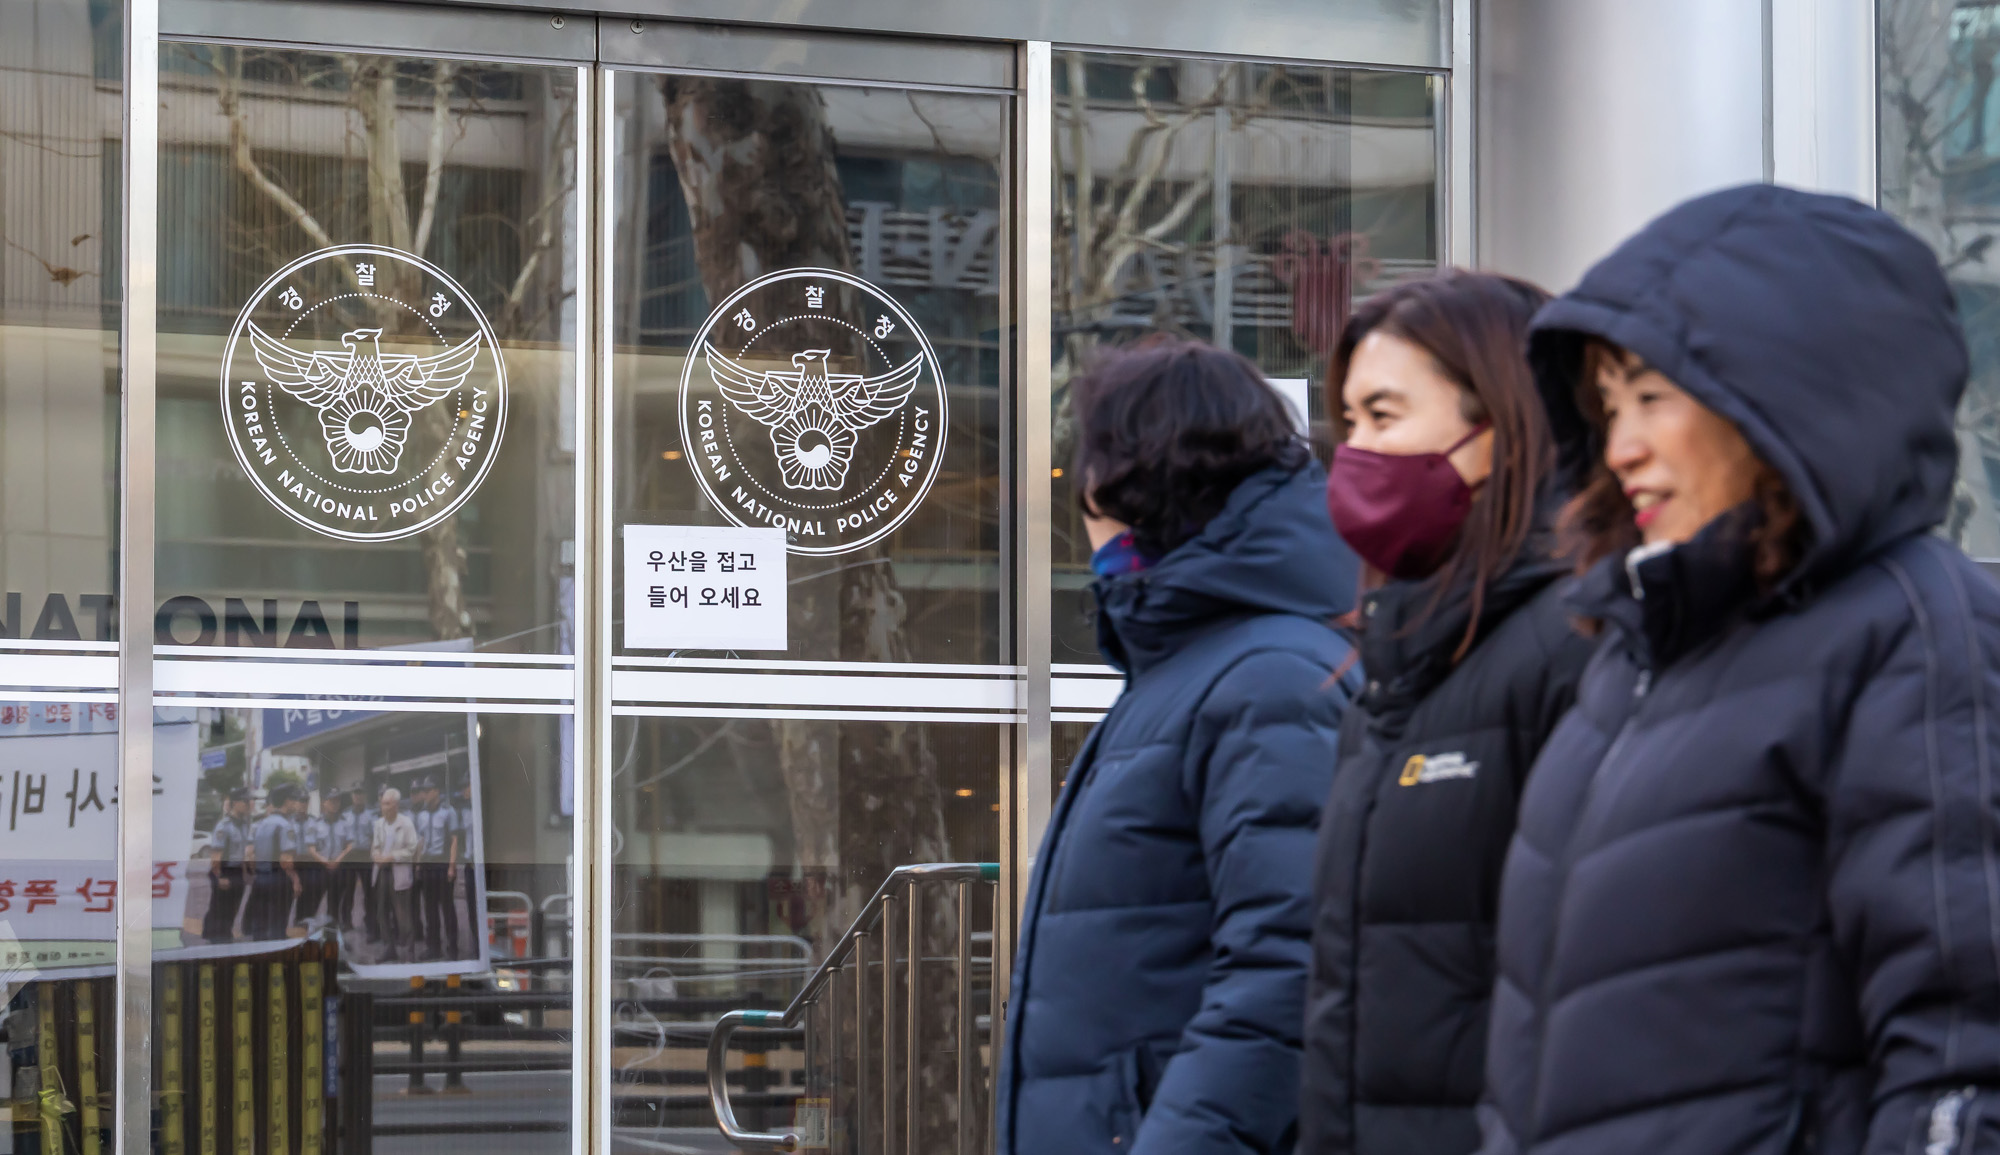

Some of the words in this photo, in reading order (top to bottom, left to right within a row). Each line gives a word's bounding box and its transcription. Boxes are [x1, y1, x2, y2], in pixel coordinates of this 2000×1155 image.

[278, 262, 452, 318] 경찰청
[733, 285, 896, 340] 경찰청
[241, 380, 277, 466] KOREAN
[277, 469, 378, 521] NATIONAL
[389, 472, 455, 518] POLICE
[457, 387, 488, 471] AGENCY
[698, 399, 731, 482] KOREAN
[731, 487, 826, 536] NATIONAL
[836, 488, 899, 533] POLICE
[898, 405, 930, 488] AGENCY
[646, 550, 708, 573] 우산을
[716, 551, 757, 573] 접고
[647, 585, 688, 609] 들어
[698, 586, 762, 609] 오세요
